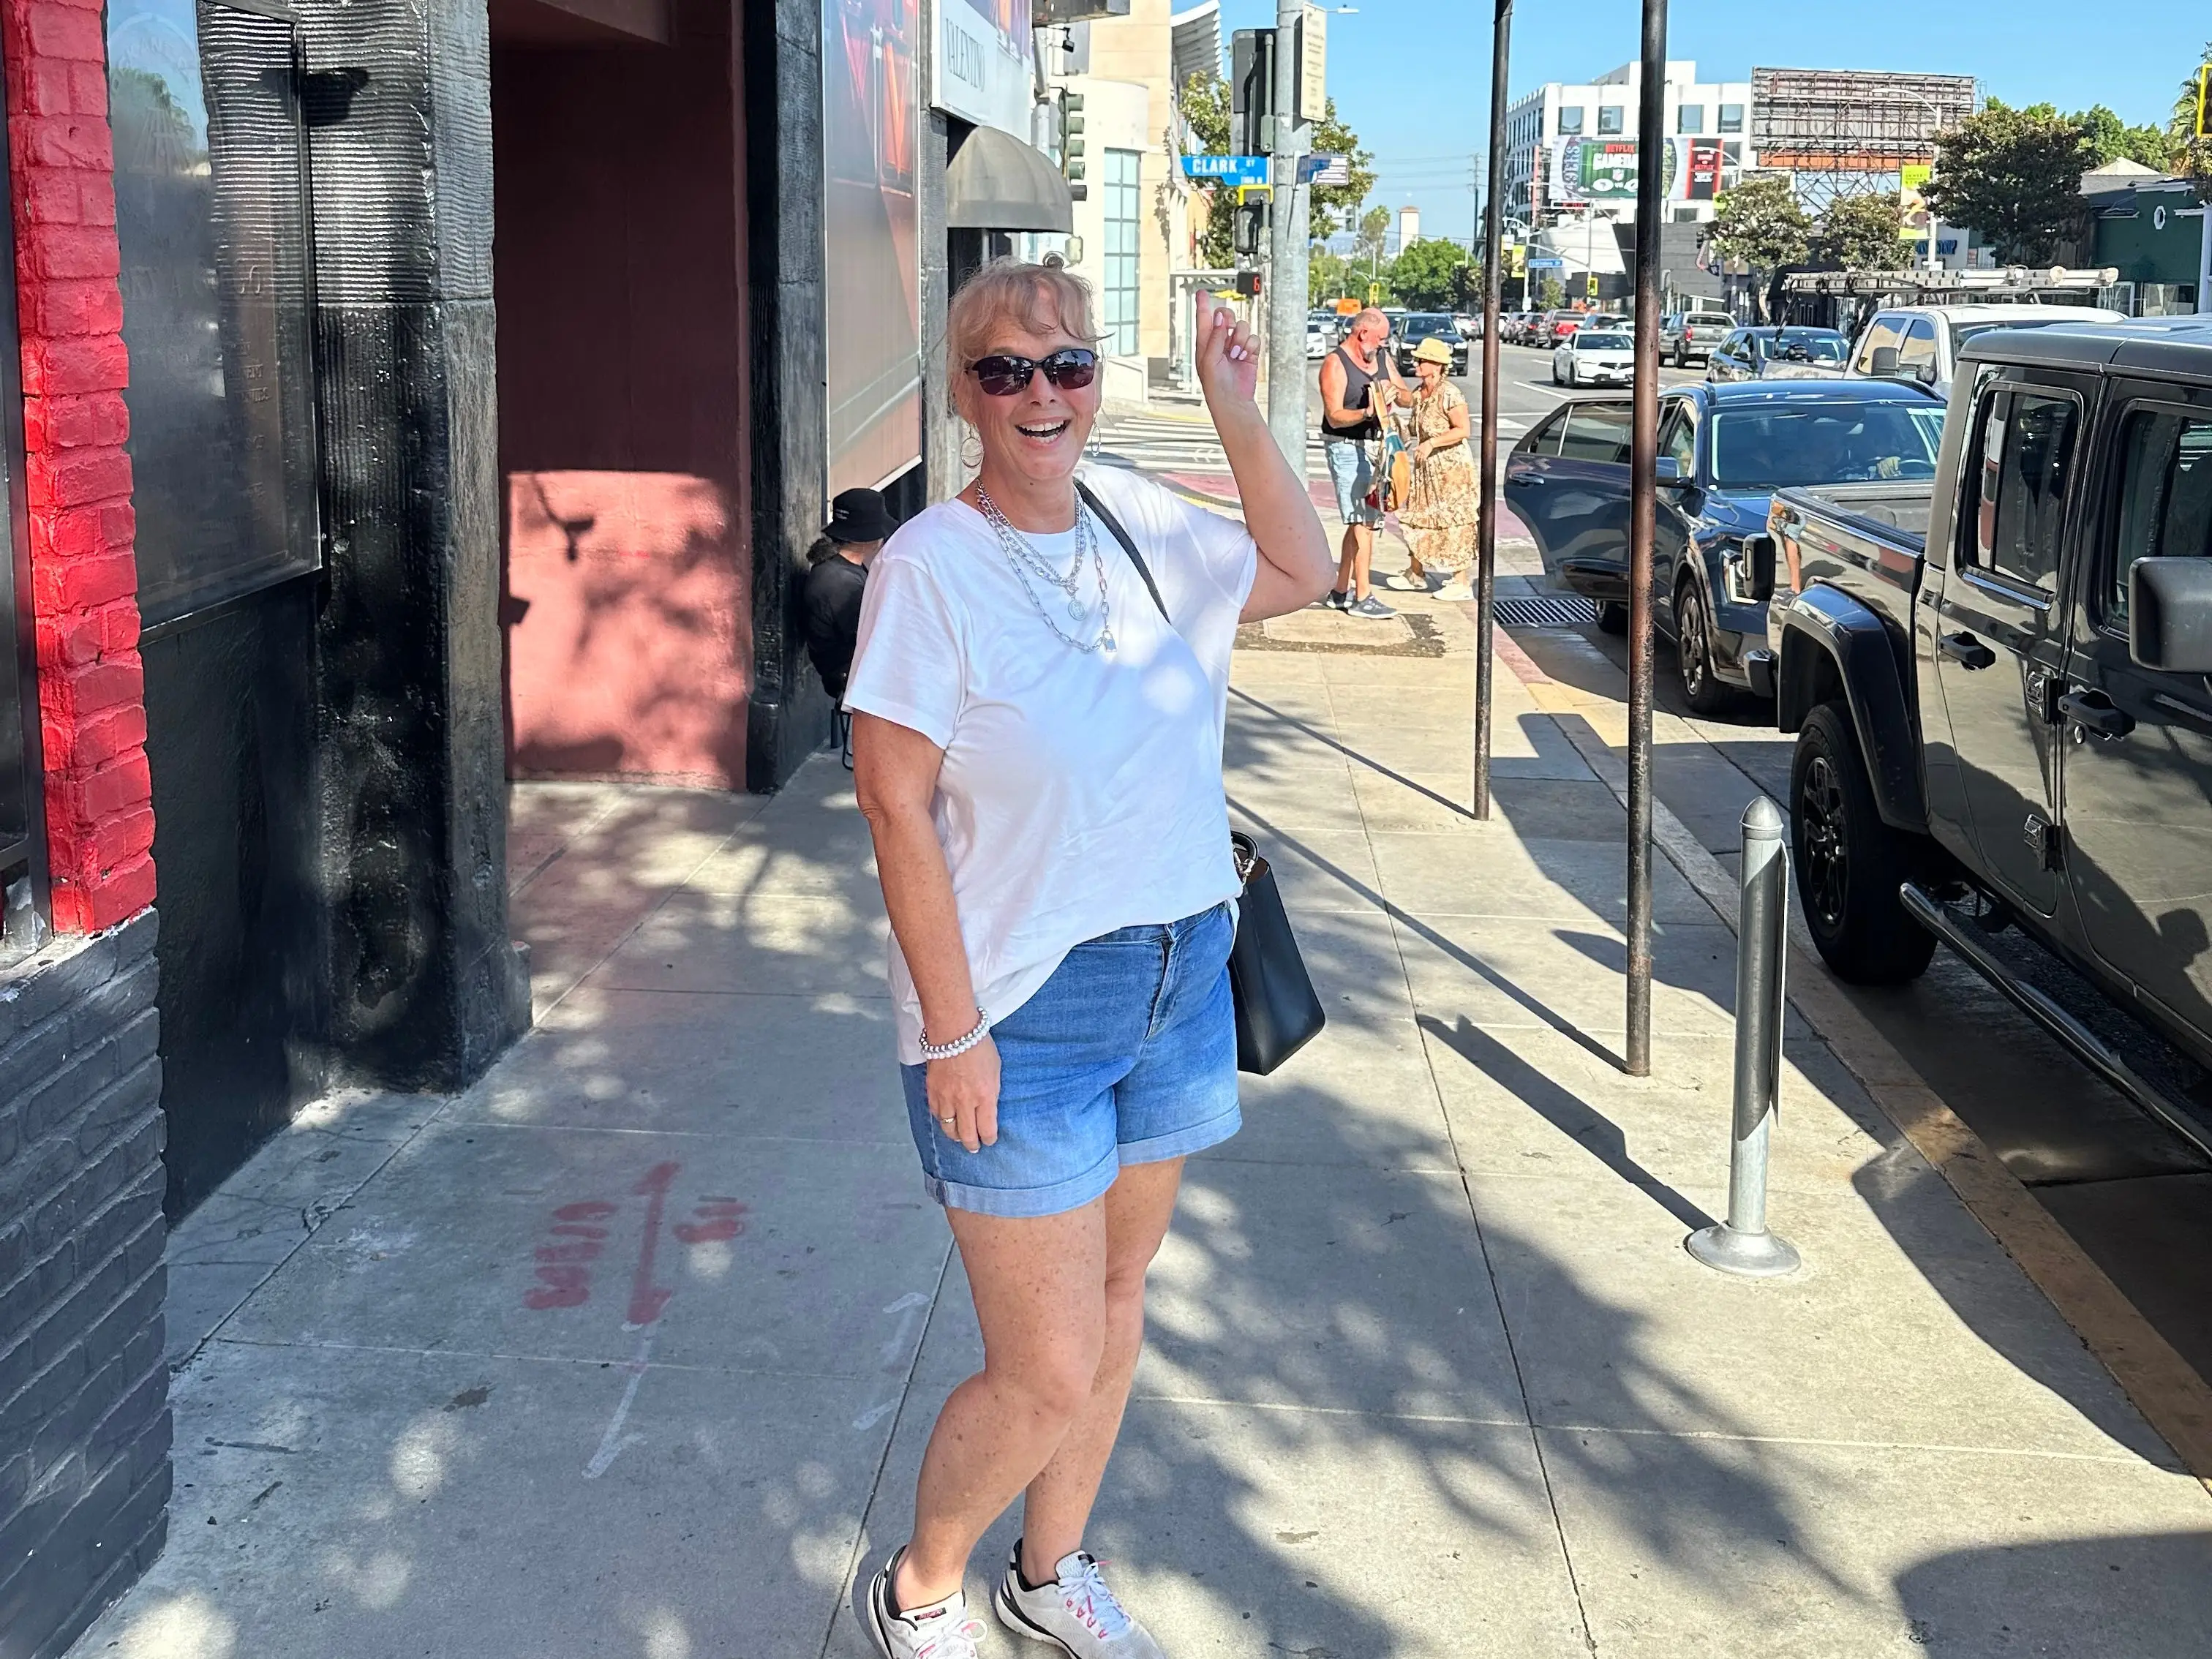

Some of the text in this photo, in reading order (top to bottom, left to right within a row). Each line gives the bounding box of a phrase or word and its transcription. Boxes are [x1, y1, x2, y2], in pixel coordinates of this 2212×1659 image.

[945, 18, 985, 92] VALENTINO
[1606, 143, 1636, 153] NETFLIX
[1193, 159, 1237, 173] CLARK
[1563, 146, 1580, 190] 49ERS
[1254, 277, 1260, 292] 6
